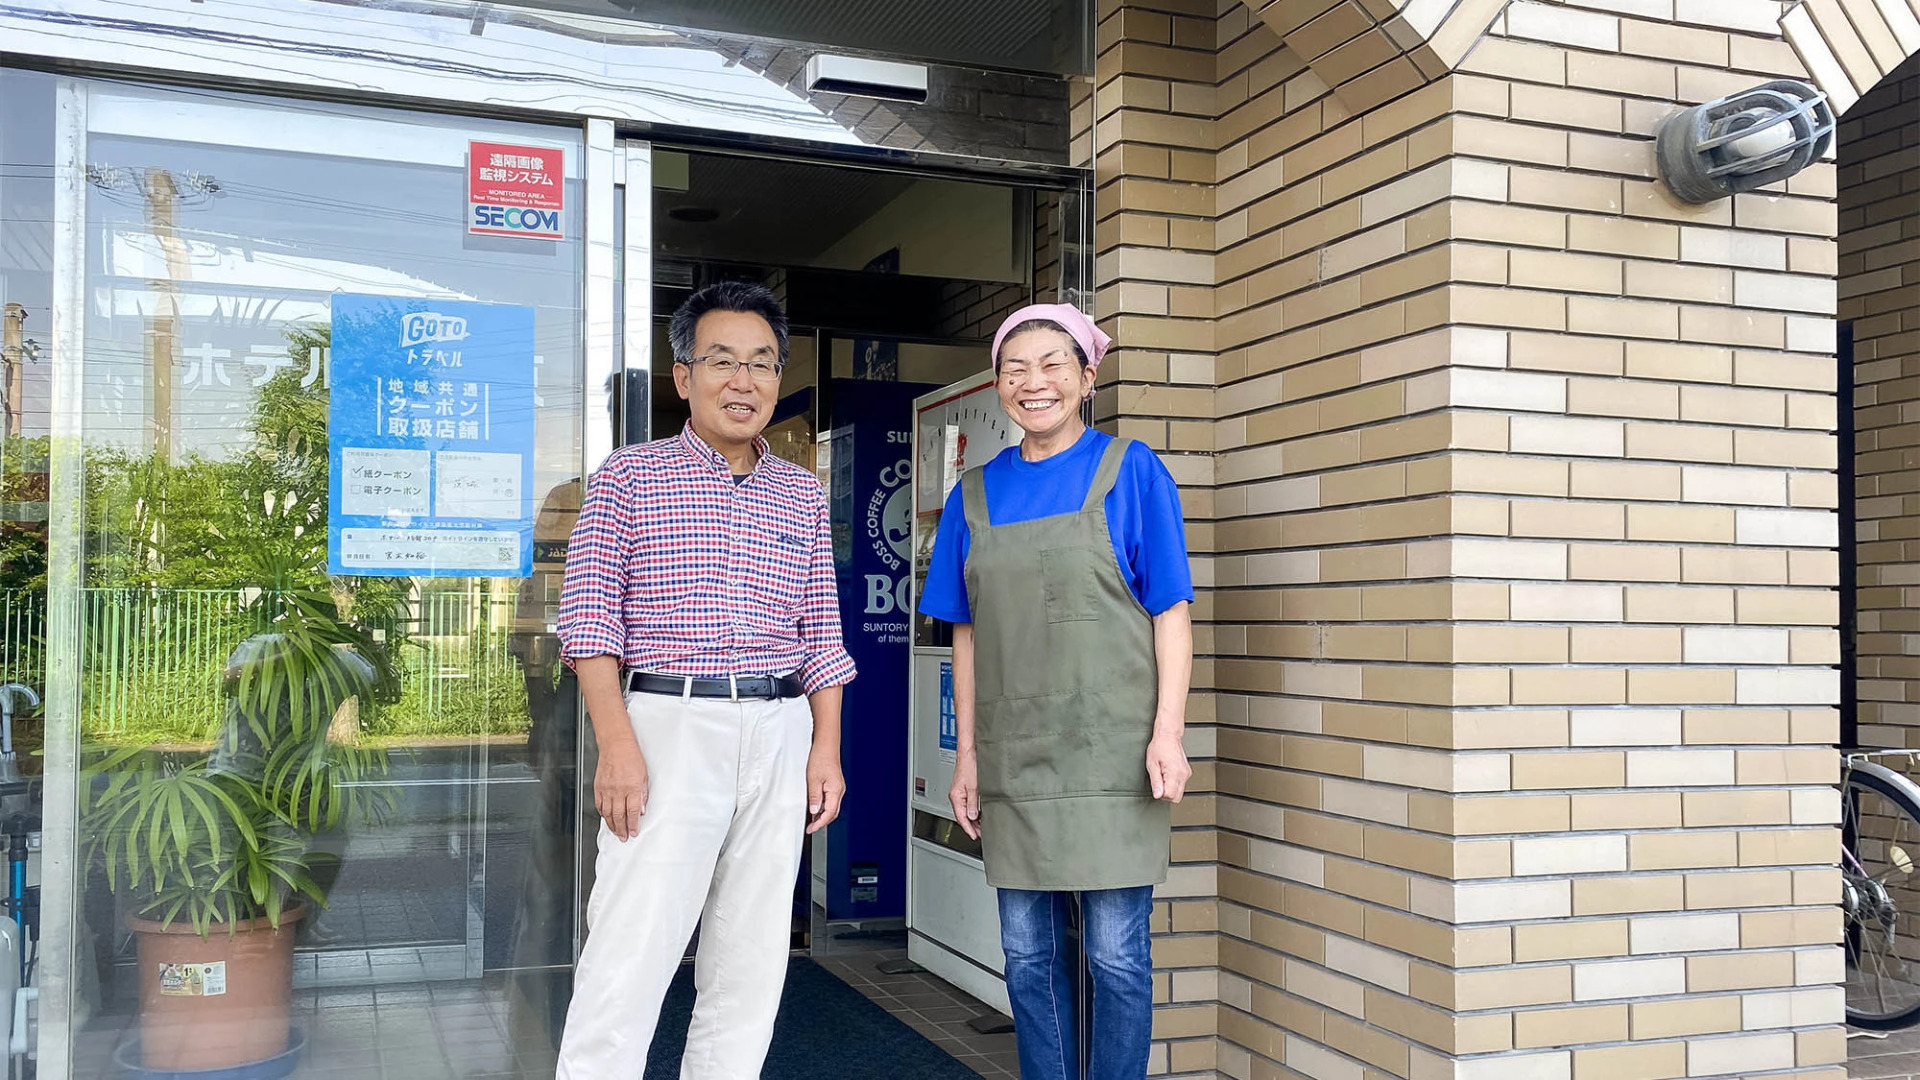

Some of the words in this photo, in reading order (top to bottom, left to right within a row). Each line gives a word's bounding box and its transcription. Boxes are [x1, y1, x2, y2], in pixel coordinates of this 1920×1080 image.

[490, 153, 544, 170] 遠隔画像
[479, 167, 554, 186] 監視システム
[488, 189, 526, 198] MONITORED
[527, 191, 545, 199] AREA
[500, 197, 528, 205] Monitoring
[475, 205, 558, 231] SECOM
[407, 348, 463, 368] トラベル
[388, 378, 478, 397] 地域共通
[388, 395, 478, 417] クーポン
[388, 417, 479, 440] 取扱店舗
[364, 469, 412, 479] 紙クーポン
[364, 485, 422, 495] 電子クーポン
[866, 488, 887, 538] COFFEE
[872, 539, 901, 571] BOSS
[863, 622, 909, 632] SUNTORY
[877, 633, 887, 643] of
[888, 633, 909, 643] them
